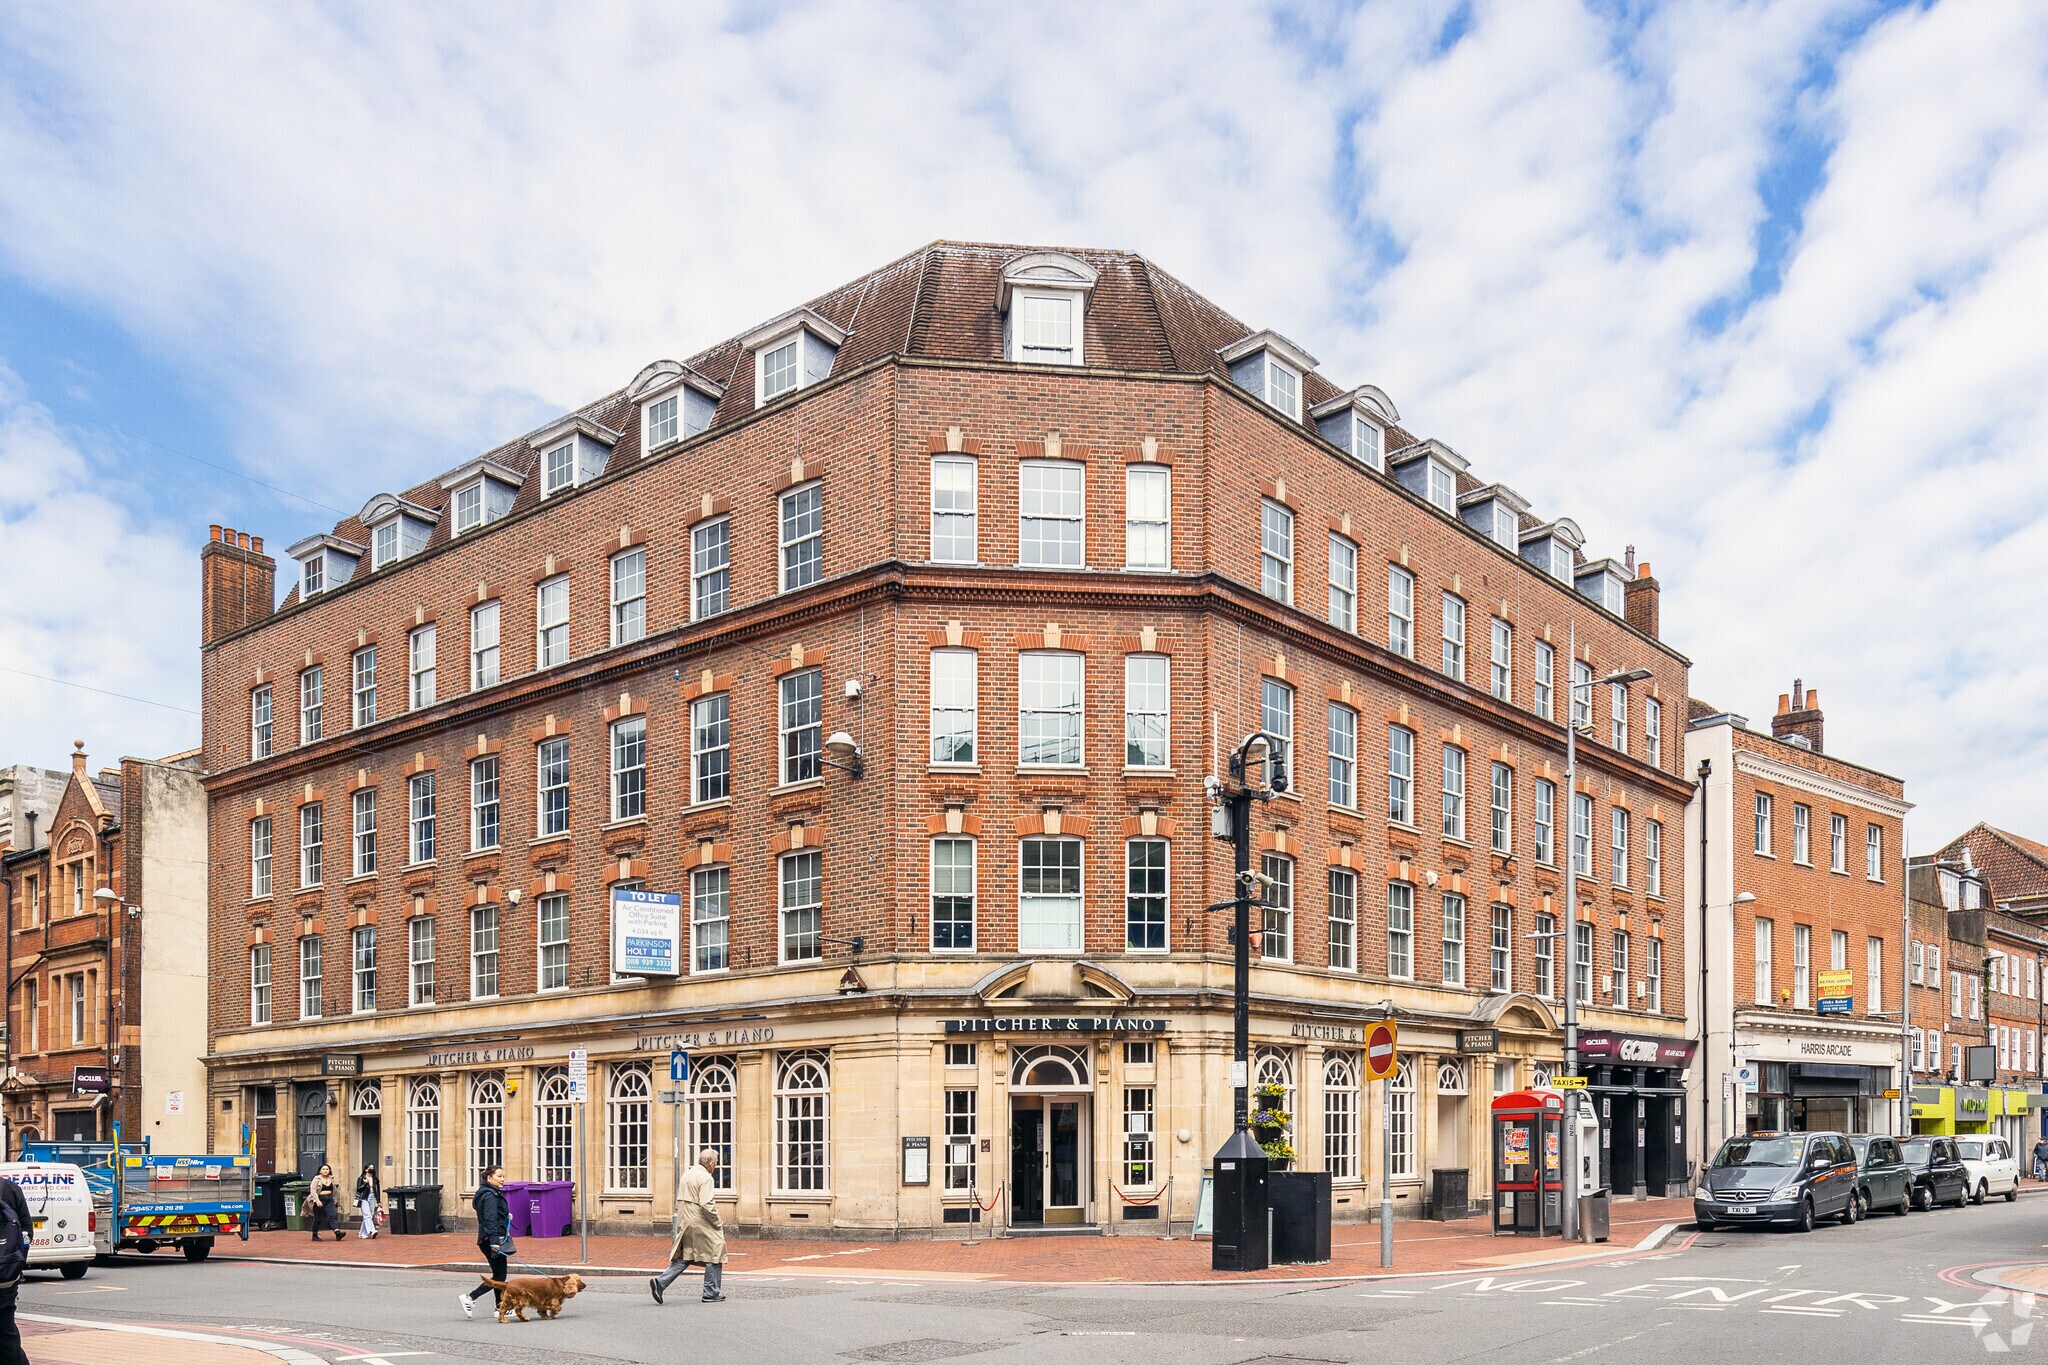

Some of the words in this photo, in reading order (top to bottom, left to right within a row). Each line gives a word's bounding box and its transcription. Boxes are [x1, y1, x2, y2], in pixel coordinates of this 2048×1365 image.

[630, 892, 646, 900] TO
[648, 893, 667, 902] LET
[634, 906, 674, 914] Conditioned
[627, 939, 670, 948] PARKINSON
[958, 1018, 1051, 1031] PITCHER
[1066, 1018, 1079, 1030] &
[1093, 1019, 1155, 1031] PIANO
[641, 1033, 701, 1049] PITCER
[708, 1032, 717, 1045] &
[725, 1027, 774, 1044] PIANO
[1296, 1024, 1344, 1040] PITCHER
[1350, 1028, 1357, 1040] &
[432, 1051, 478, 1066] PITCHER
[484, 1050, 491, 1061] &
[497, 1046, 534, 1060] PIANO
[1801, 1043, 1825, 1055] HARRIS
[1826, 1045, 1851, 1056] ARCADE
[1430, 1277, 1588, 1292] NO
[1600, 1283, 2008, 1314] ENTRY
